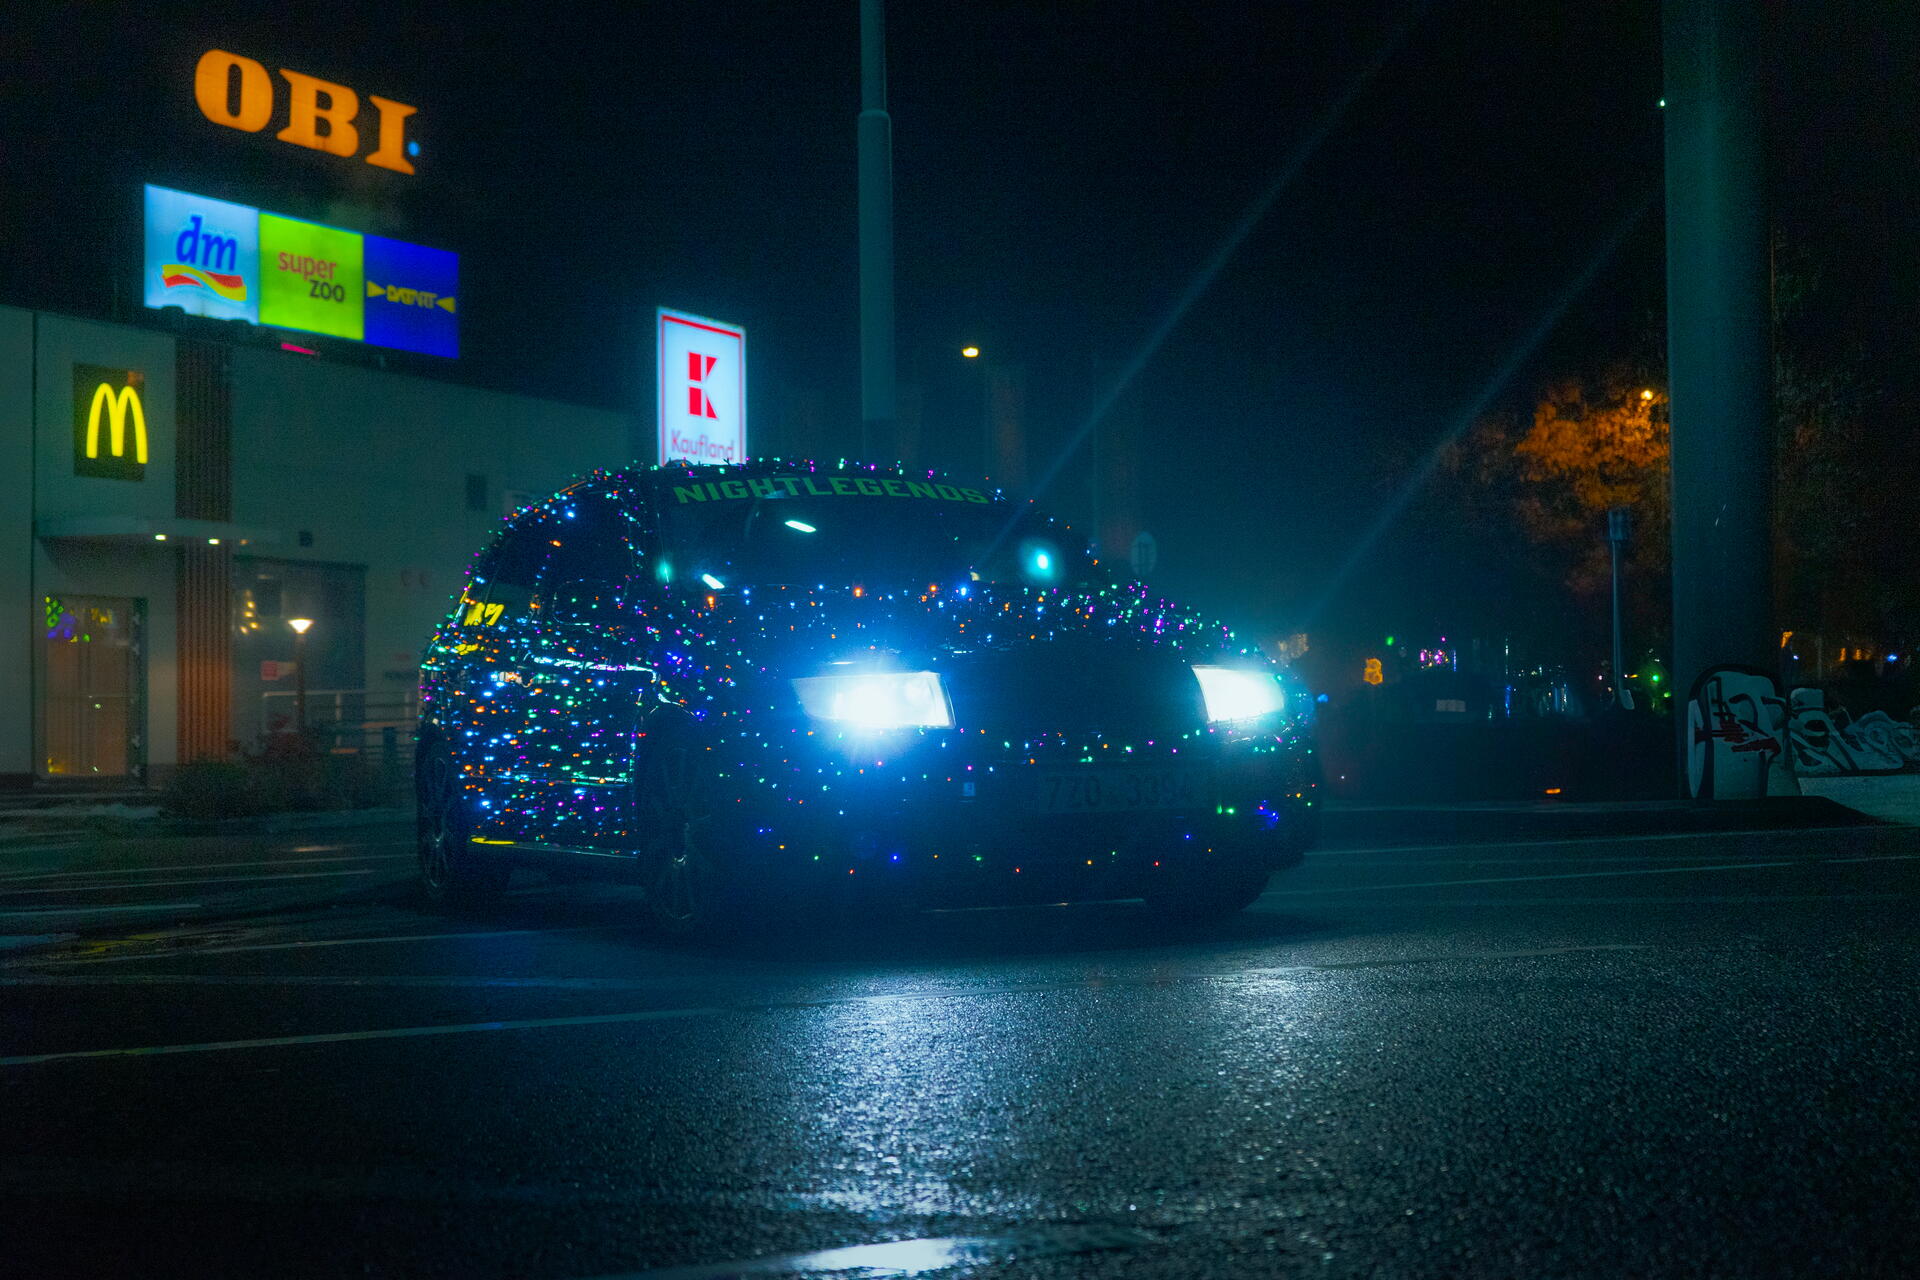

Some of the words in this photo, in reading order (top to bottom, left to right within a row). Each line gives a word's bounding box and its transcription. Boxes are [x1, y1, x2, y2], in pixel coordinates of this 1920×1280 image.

[175, 215, 238, 272] dm
[277, 251, 337, 281] super
[671, 428, 735, 460] Kaufland
[673, 476, 990, 504] NIGHTLEGENDS
